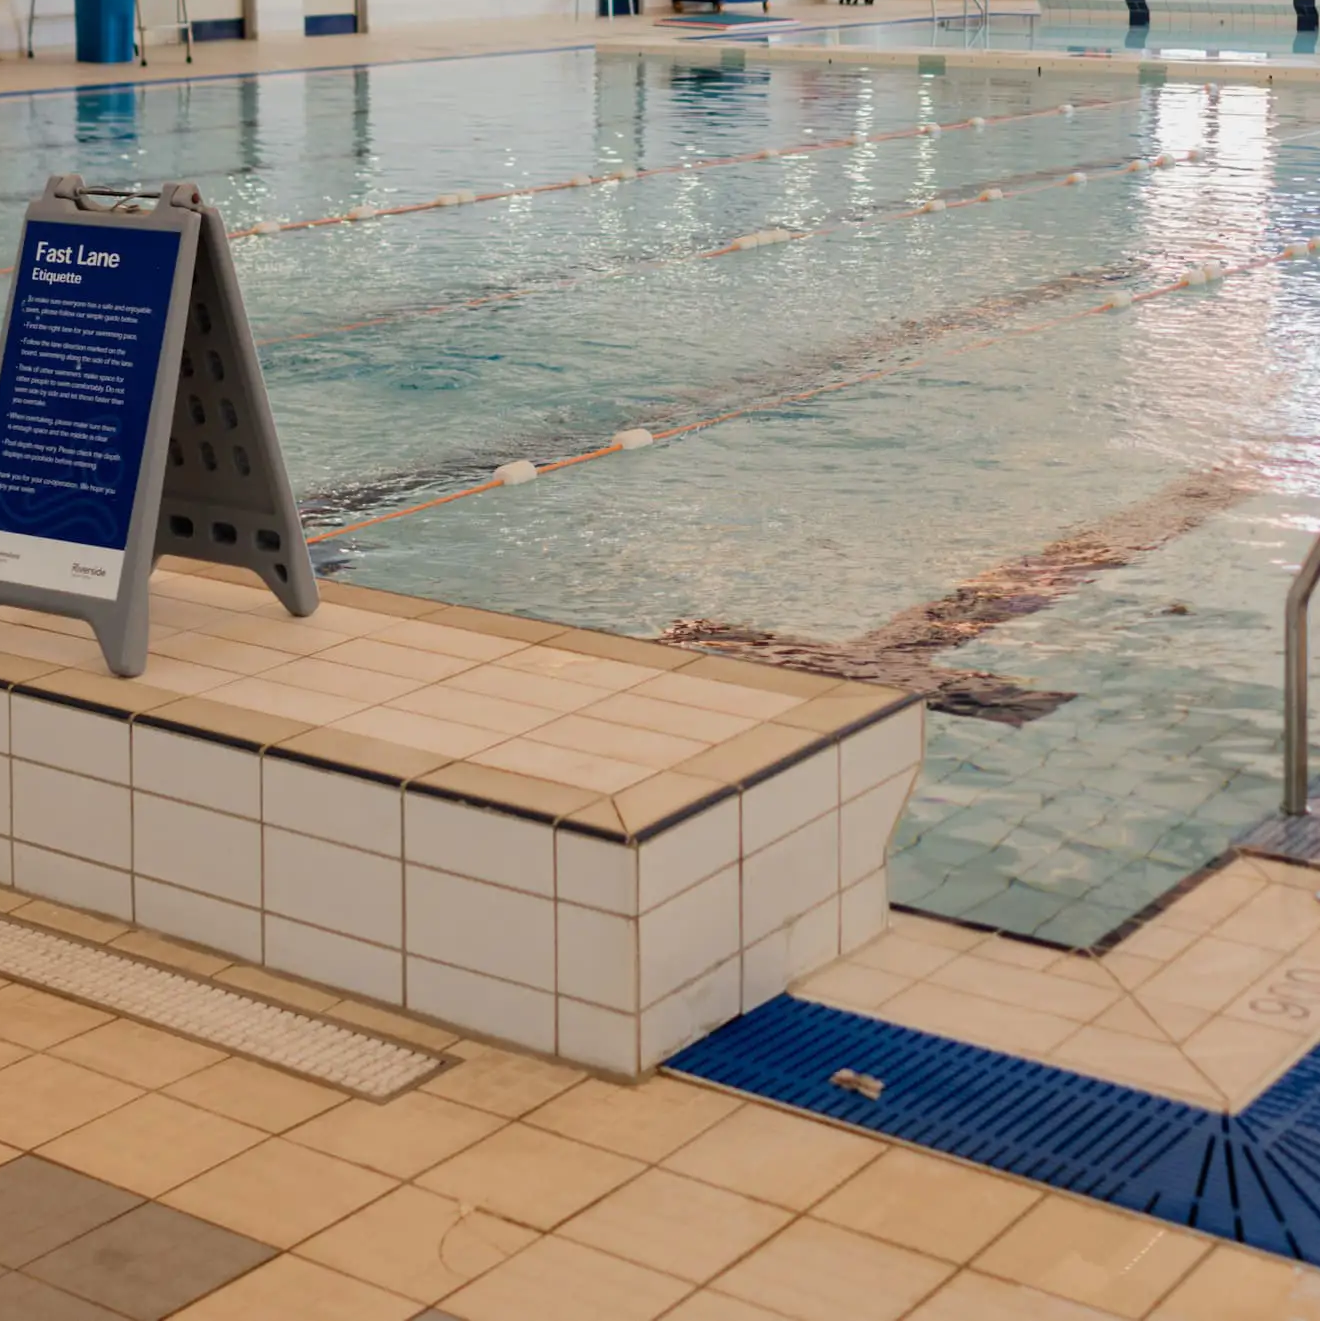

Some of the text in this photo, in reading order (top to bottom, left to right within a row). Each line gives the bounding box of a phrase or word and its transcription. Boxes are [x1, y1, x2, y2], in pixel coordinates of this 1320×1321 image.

[36, 241, 120, 268] Fast Lane
[32, 267, 82, 285] Etiquette
